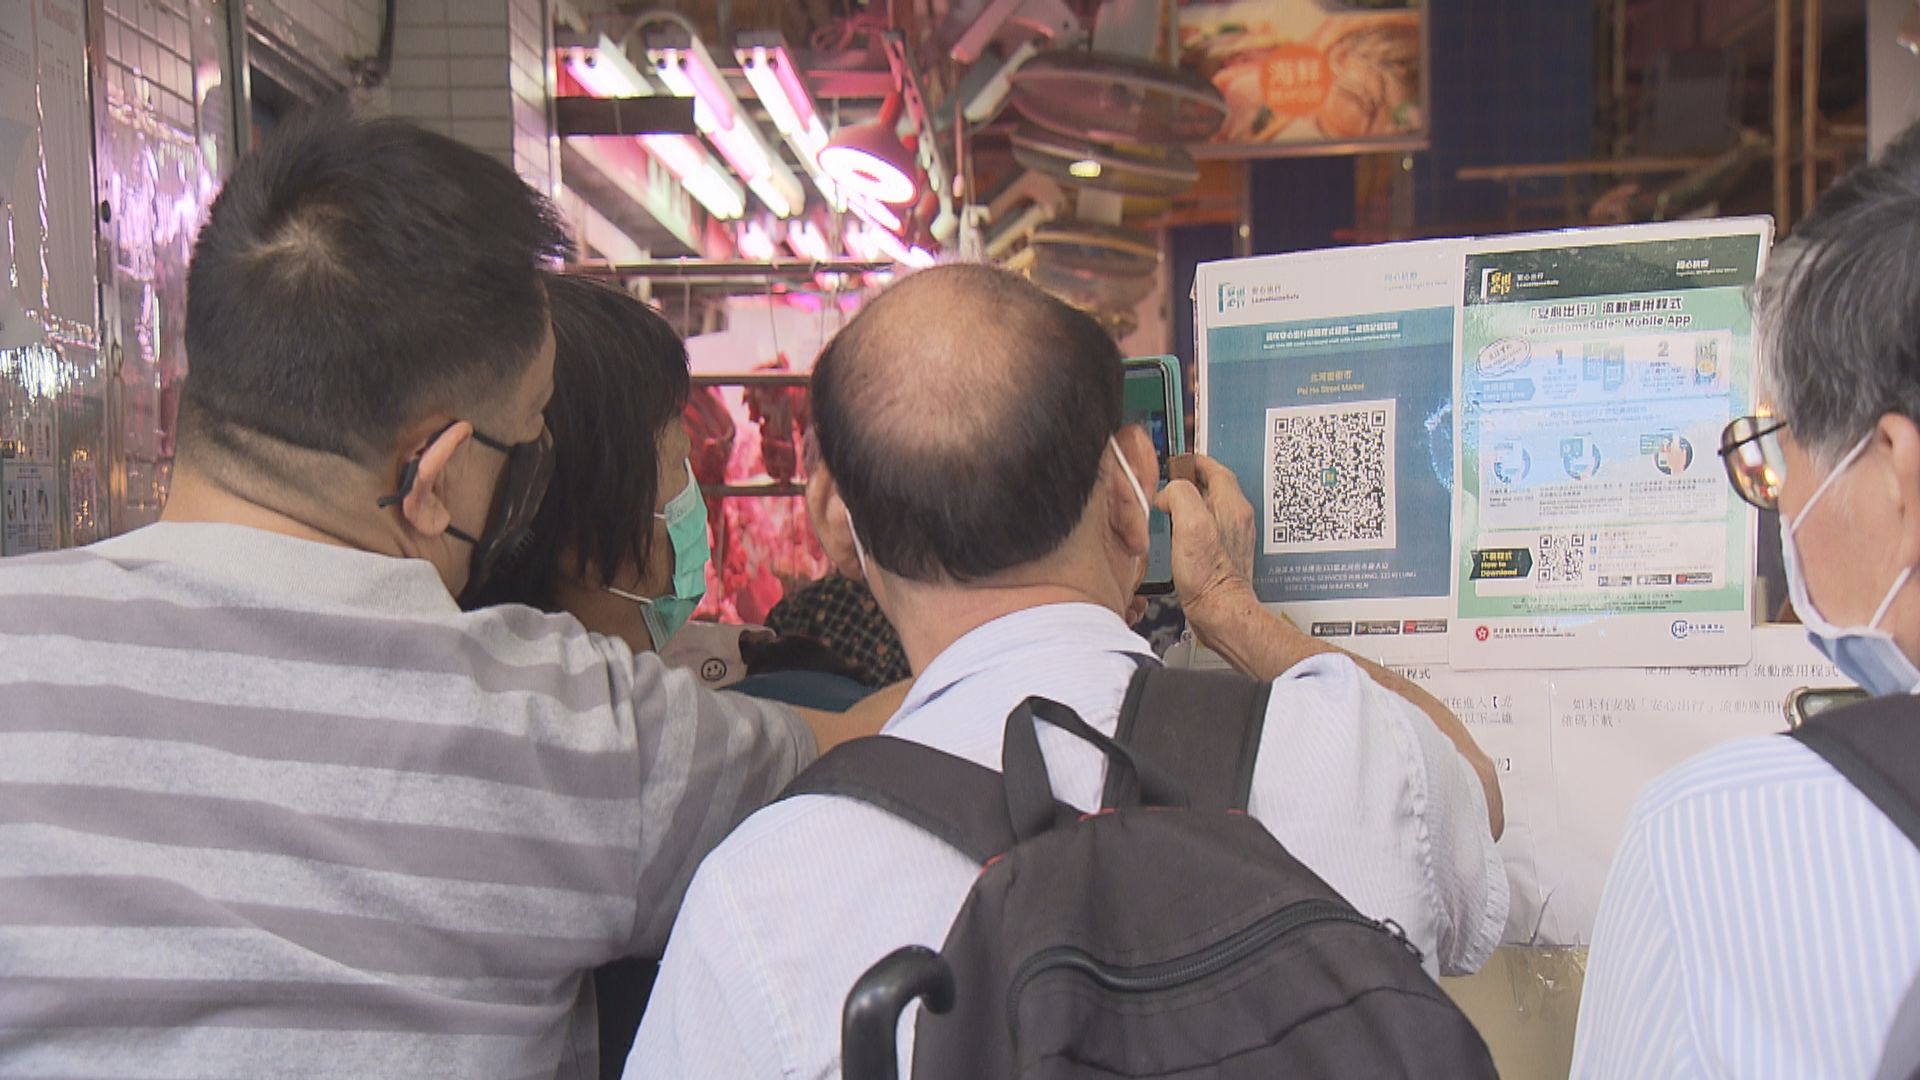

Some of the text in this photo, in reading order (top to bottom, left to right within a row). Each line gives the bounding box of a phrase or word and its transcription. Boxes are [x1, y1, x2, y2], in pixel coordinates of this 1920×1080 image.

[1624, 315, 1664, 328] Mobile
[1667, 314, 1691, 327] App
[1657, 341, 1669, 357] 2
